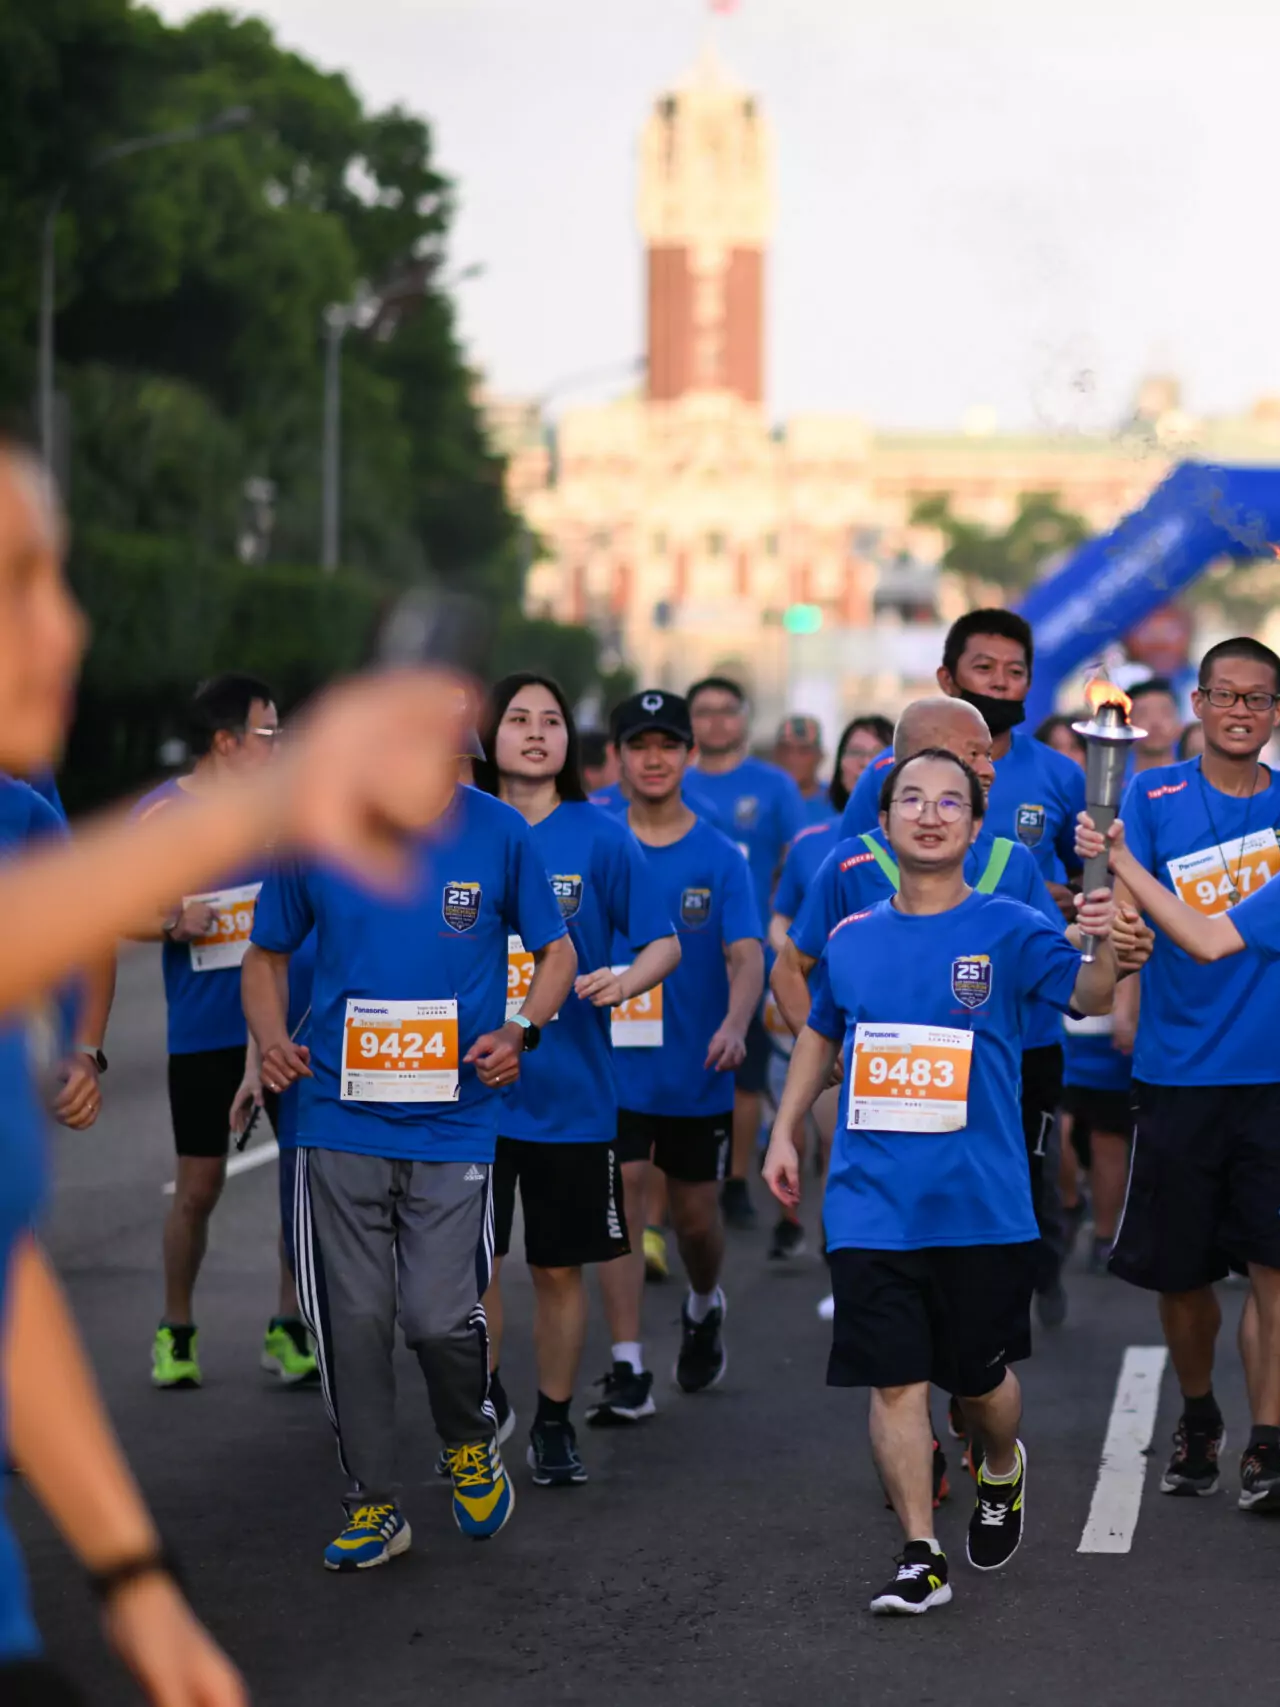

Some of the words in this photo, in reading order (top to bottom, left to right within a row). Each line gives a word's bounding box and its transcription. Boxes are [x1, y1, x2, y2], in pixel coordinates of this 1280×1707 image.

[1021, 811, 1037, 826] 25
[553, 882, 572, 896] 25
[1196, 861, 1272, 905] 9471
[449, 890, 470, 906] 25
[957, 964, 980, 980] 25
[354, 1006, 389, 1015] Panasonic
[864, 1031, 899, 1039] Panasonic
[360, 1031, 446, 1058] 9424
[868, 1056, 954, 1088] 9483
